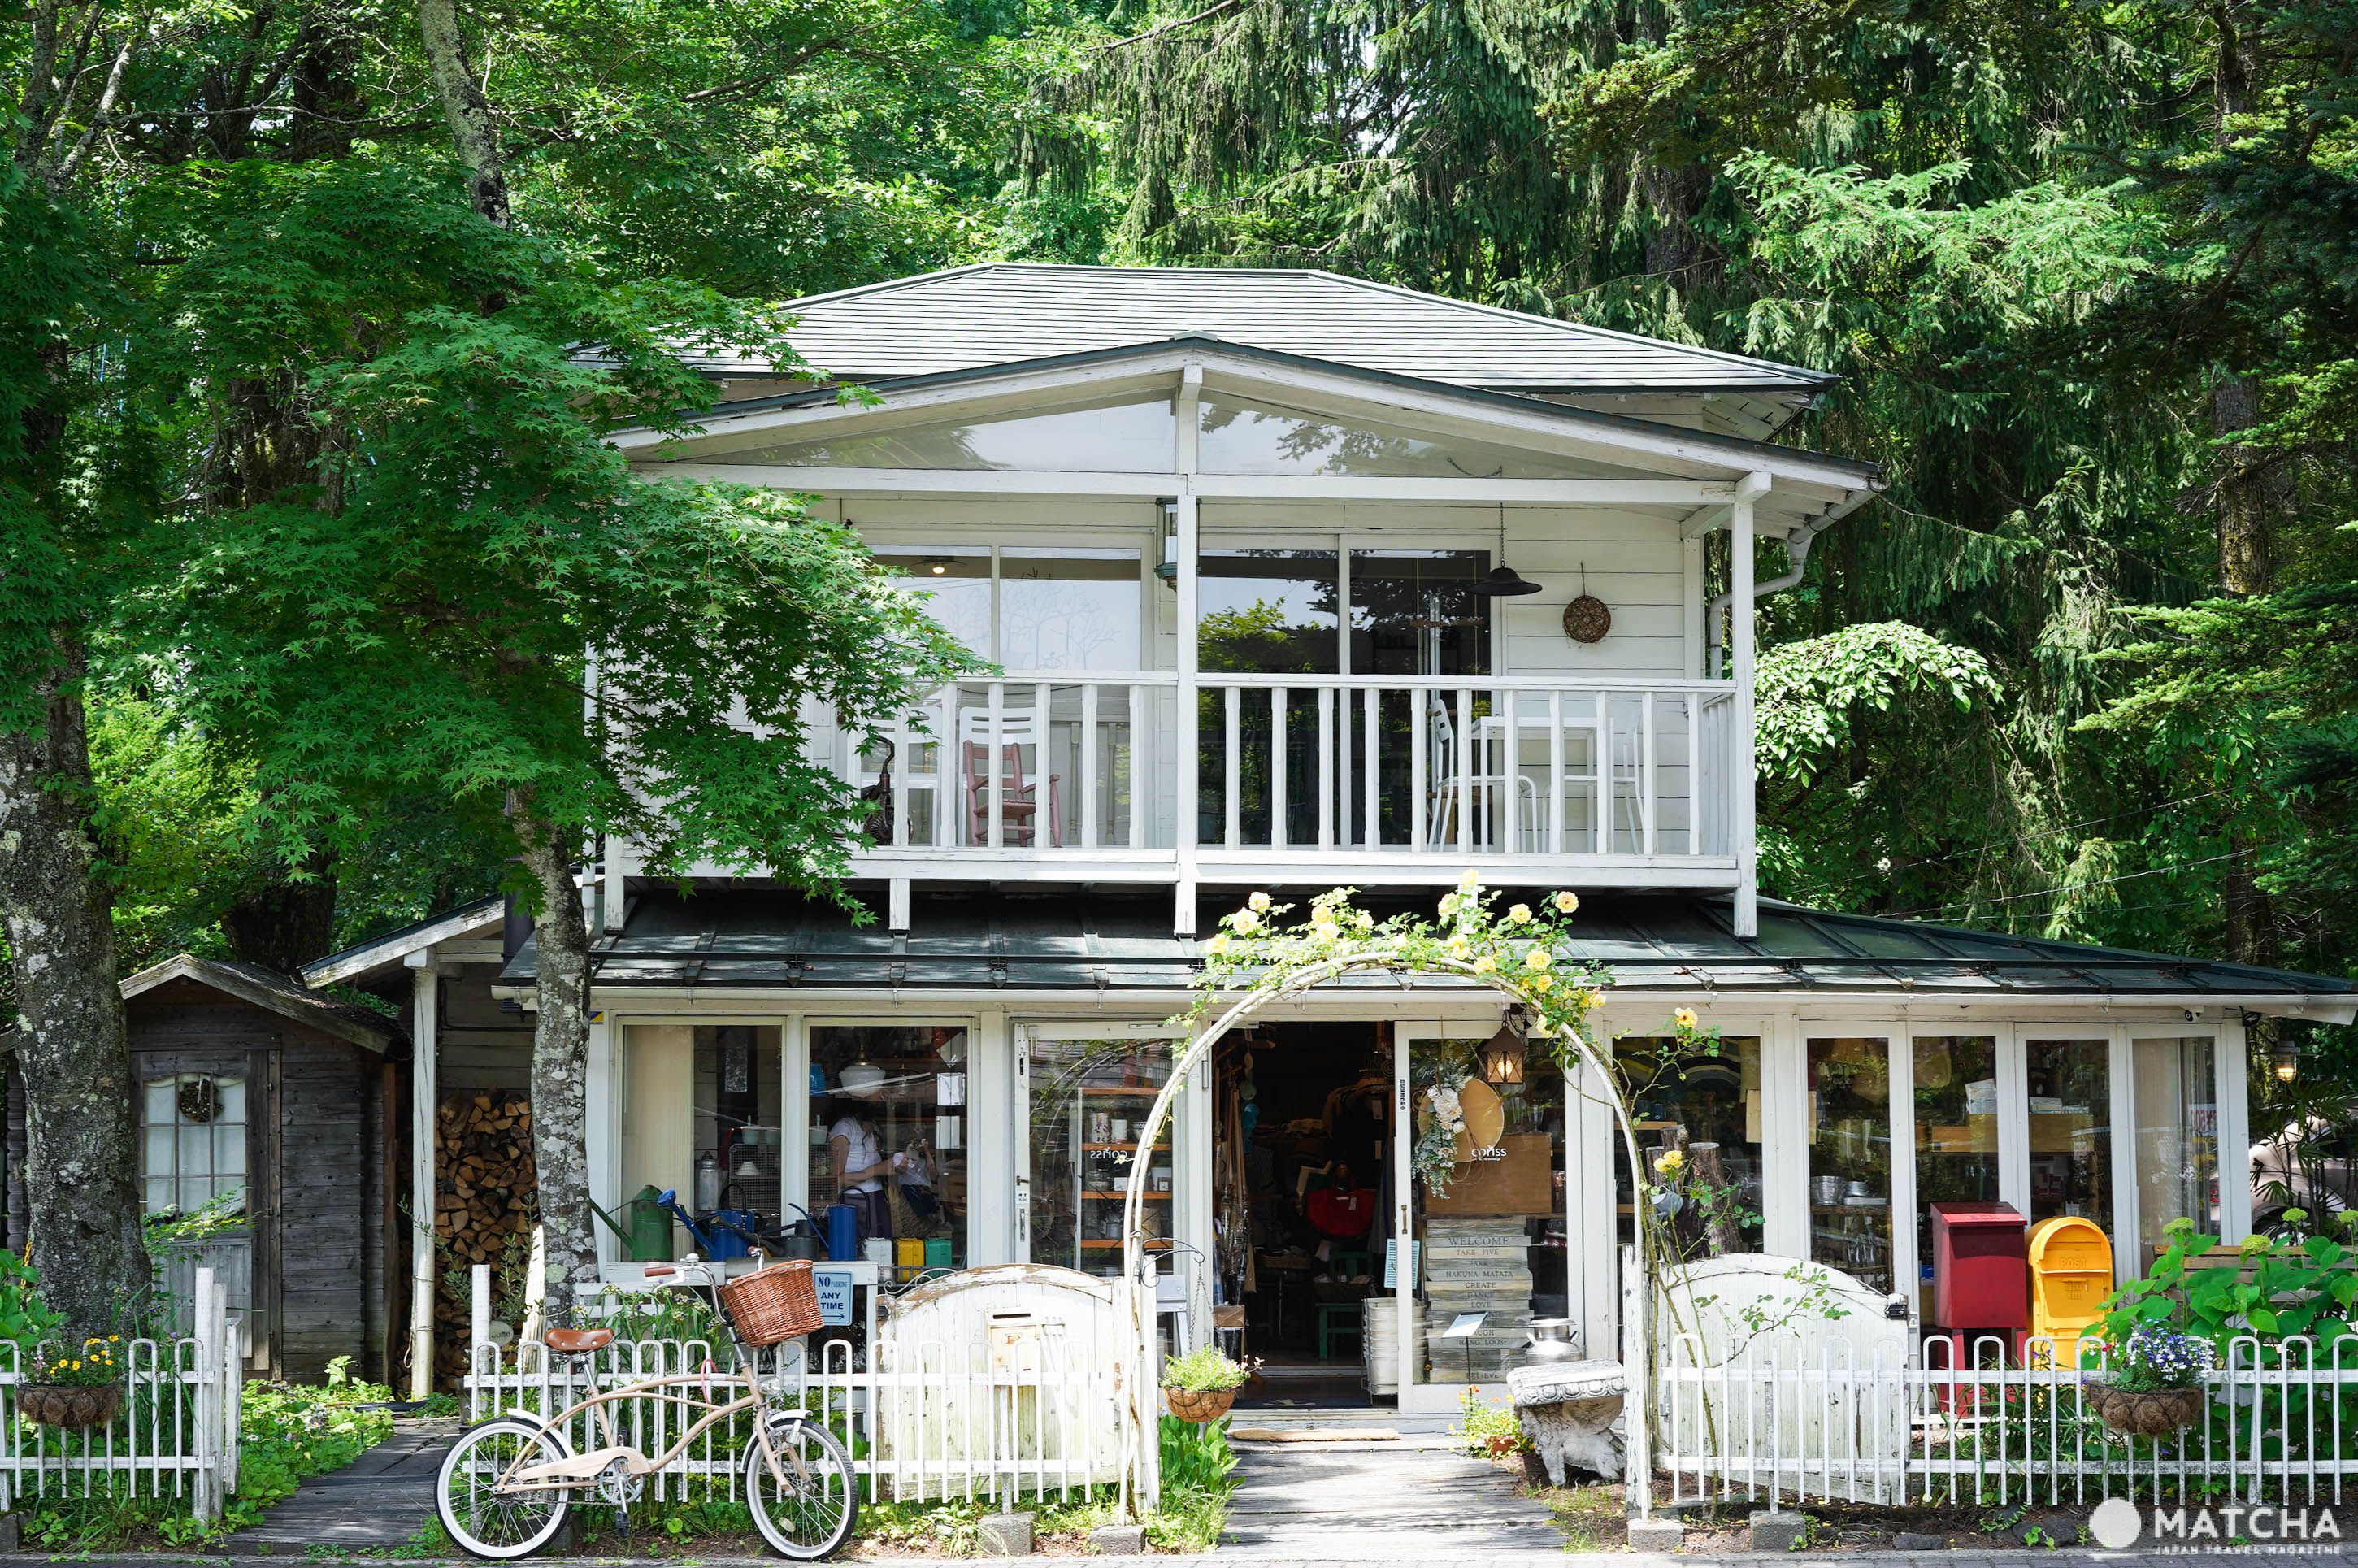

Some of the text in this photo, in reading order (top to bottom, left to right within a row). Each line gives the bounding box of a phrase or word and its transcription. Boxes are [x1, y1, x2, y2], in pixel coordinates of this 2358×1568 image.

[1416, 1066, 1435, 1079] Ope
[1471, 1145, 1506, 1157] coriss
[1448, 1237, 1509, 1245] WELCOME
[2061, 1258, 2087, 1268] POST
[819, 1276, 831, 1288] NO
